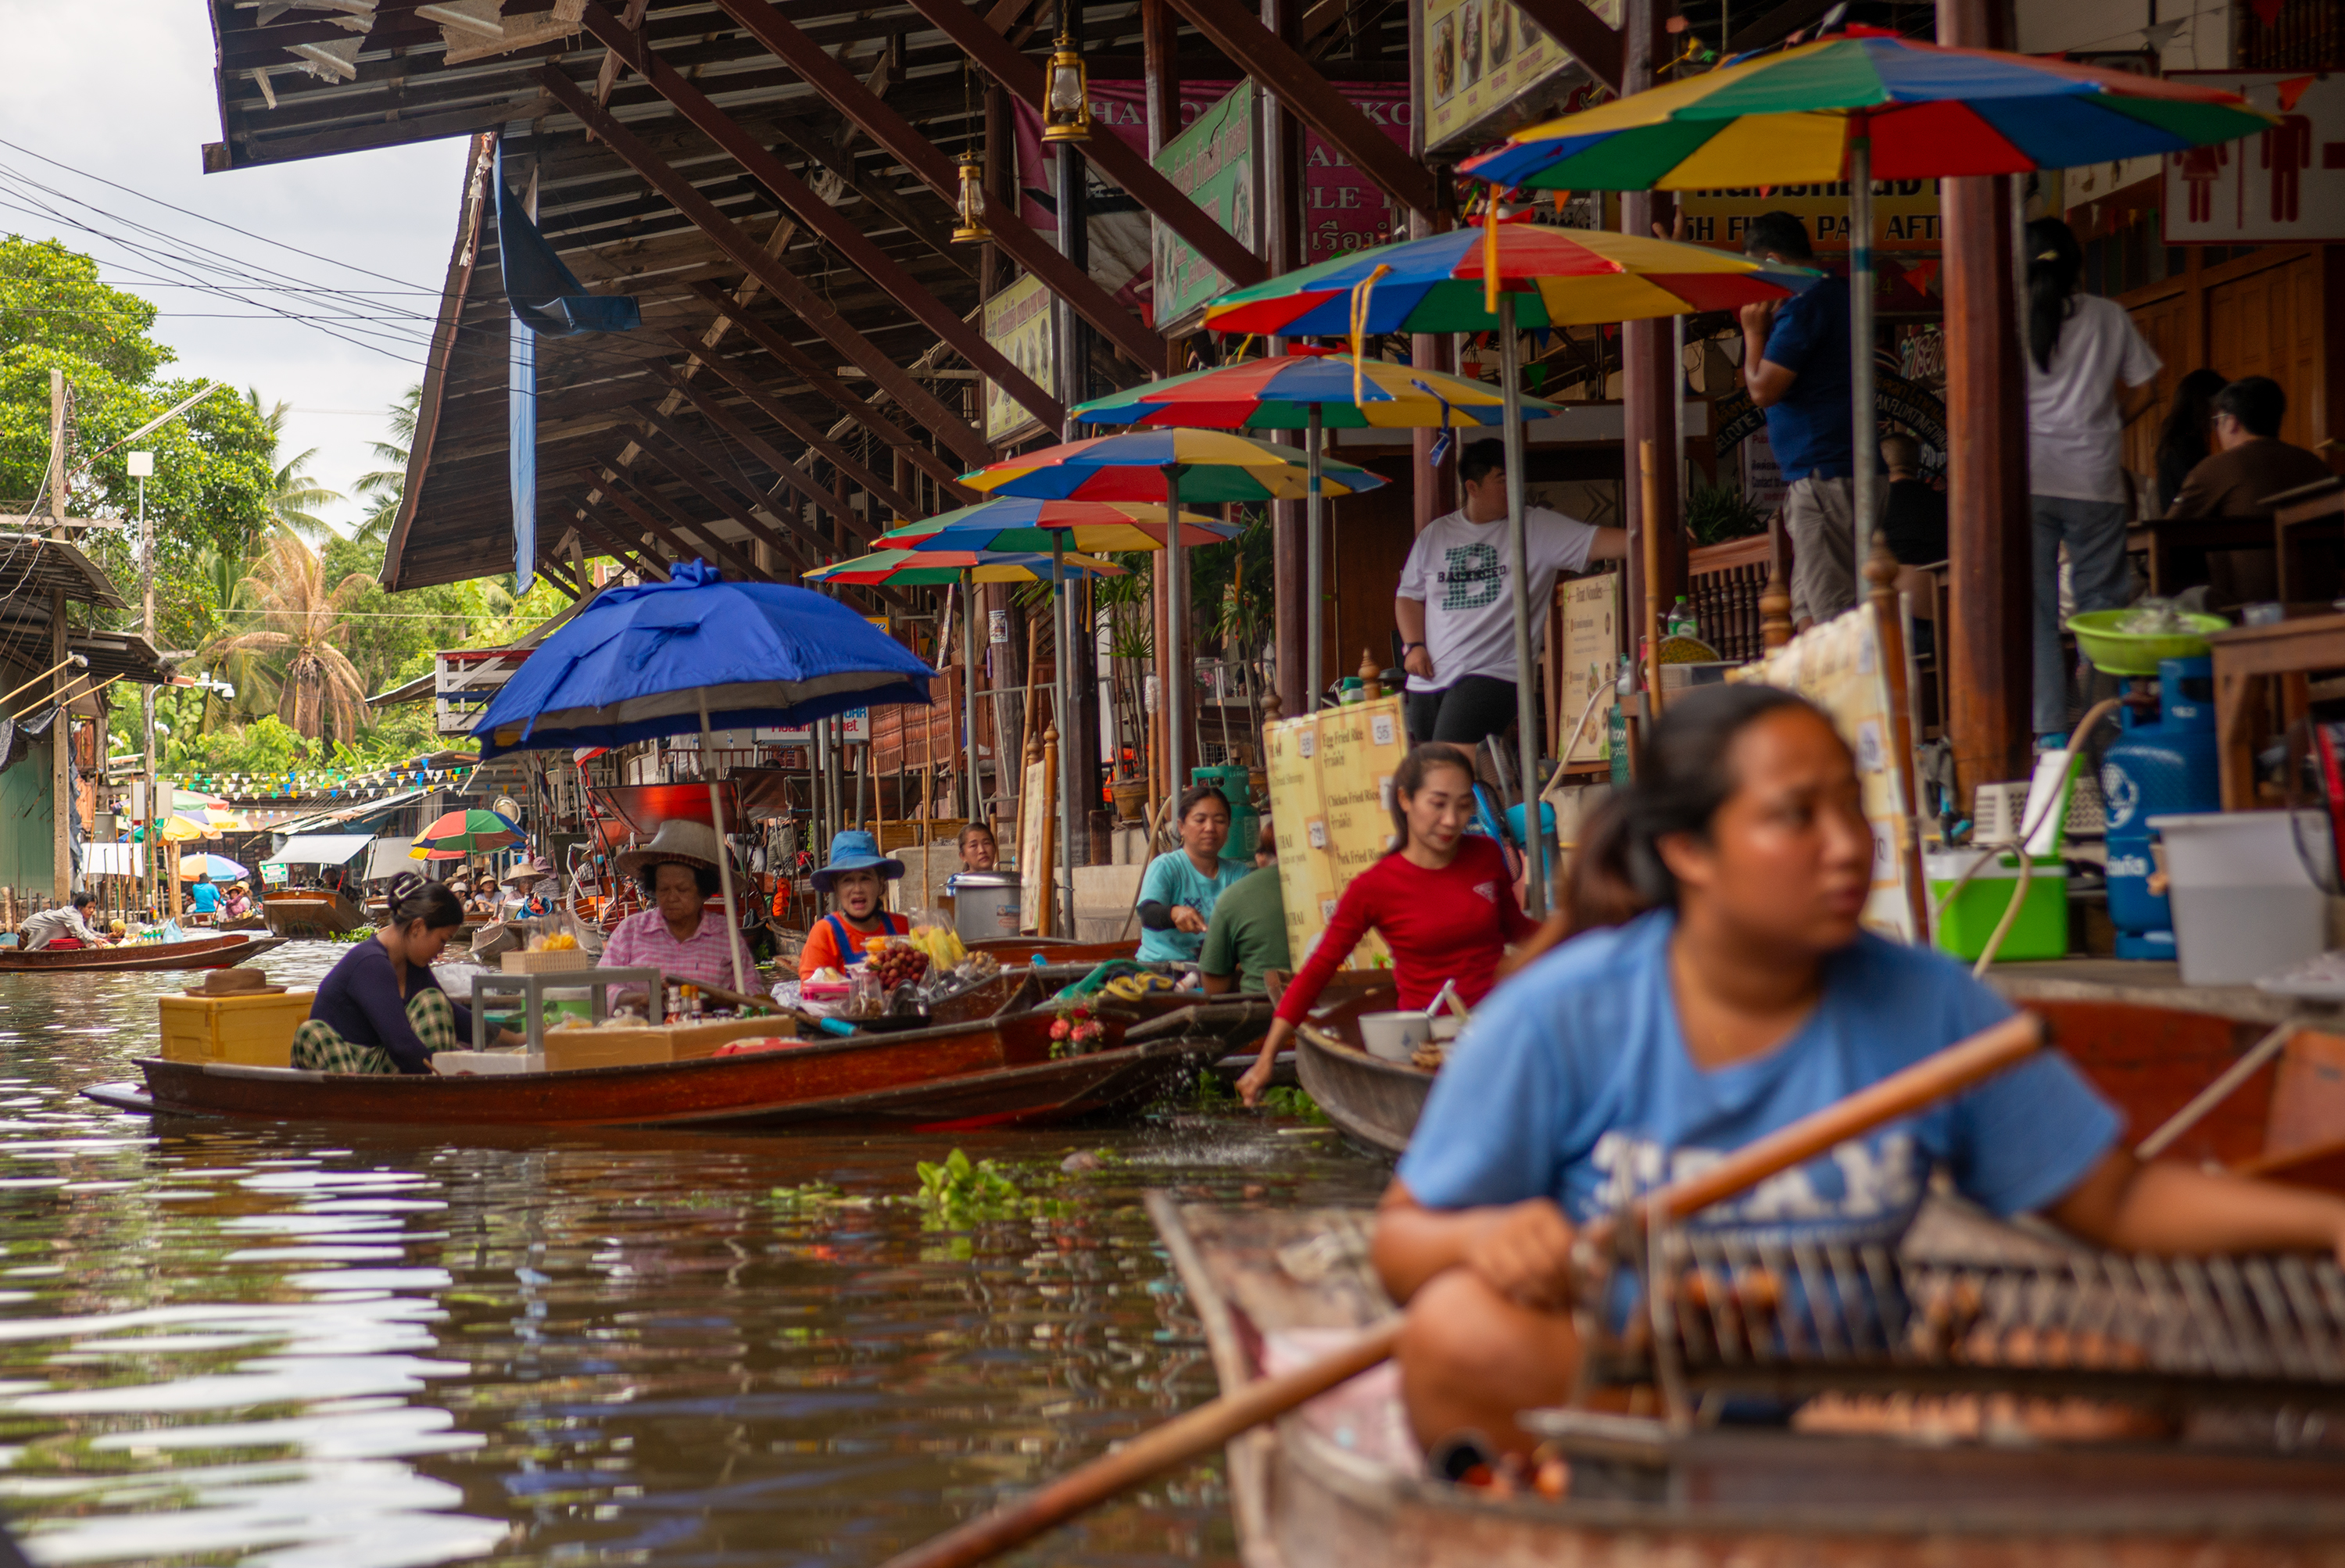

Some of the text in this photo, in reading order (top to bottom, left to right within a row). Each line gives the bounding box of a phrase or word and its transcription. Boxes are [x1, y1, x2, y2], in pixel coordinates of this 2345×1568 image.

[1334, 729, 1350, 744] Fried
[1351, 728, 1363, 741] Rice
[1348, 791, 1364, 806] Fried
[1364, 789, 1380, 804] Rice
[1351, 849, 1367, 864] Fried
